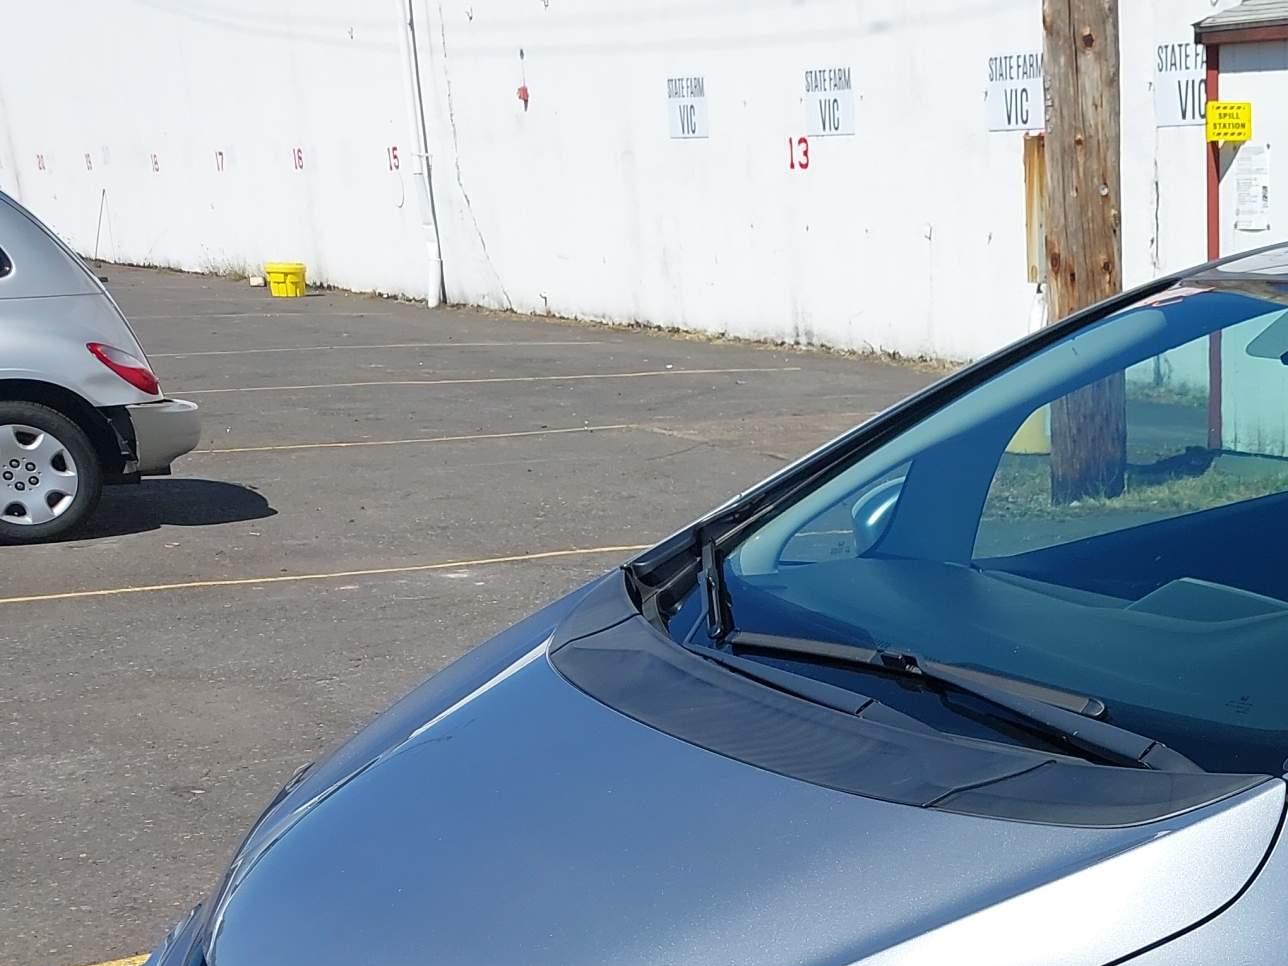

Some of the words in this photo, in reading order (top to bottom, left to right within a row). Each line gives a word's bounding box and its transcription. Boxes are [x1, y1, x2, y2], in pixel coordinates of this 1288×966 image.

[988, 55, 1014, 82] STATE
[1157, 43, 1190, 72] STATE
[667, 78, 685, 99] STATE
[686, 77, 705, 98] FARM
[805, 69, 828, 93] STATE
[829, 67, 851, 91] FARM
[1004, 87, 1029, 125] VIC
[1178, 78, 1206, 120] VIC
[679, 104, 697, 135] VIC
[819, 98, 839, 132] VIC
[1213, 122, 1246, 130] STATION
[1218, 112, 1240, 120] SPILL
[215, 151, 224, 172] 17
[292, 147, 304, 170] 16
[387, 146, 400, 171] 15
[789, 137, 809, 170] 13
